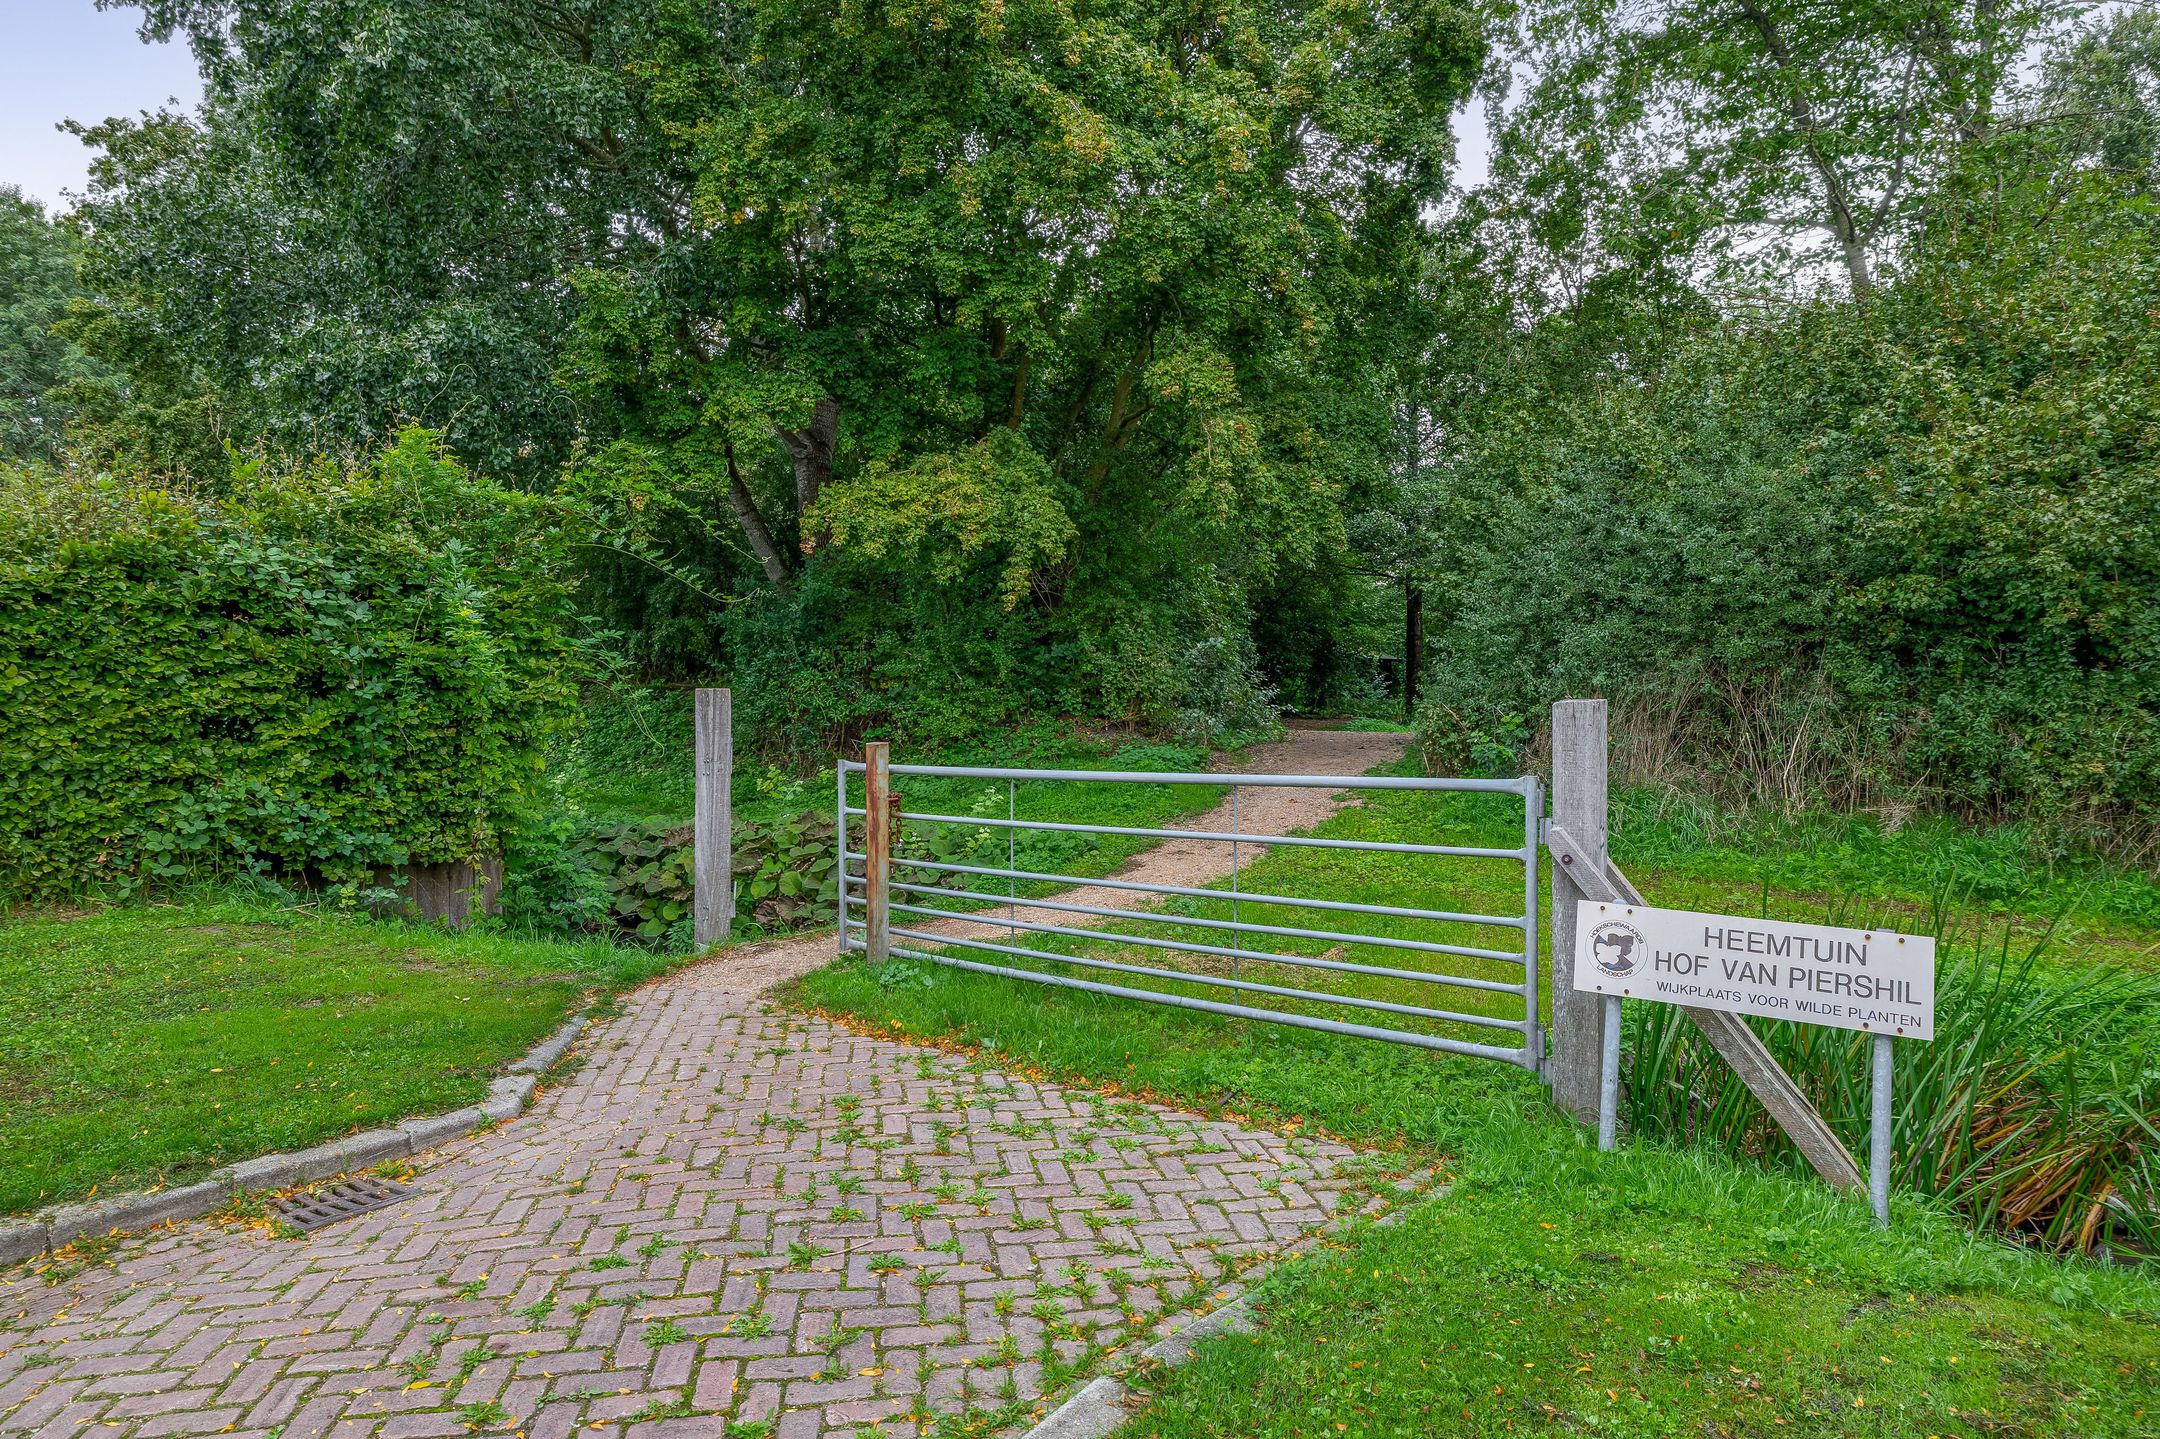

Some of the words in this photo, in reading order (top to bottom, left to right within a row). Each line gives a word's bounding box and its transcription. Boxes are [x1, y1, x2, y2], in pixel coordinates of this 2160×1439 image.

[1704, 926, 1867, 967] HEEMTUIN
[1596, 965, 1634, 978] LANDSCHAP
[1655, 949, 1710, 976] HOF
[1721, 958, 1778, 987] VAN
[1788, 966, 1922, 1006] PIERSHIL
[1656, 980, 1742, 1003] WIJKPLAATS
[1748, 993, 1789, 1009] VOOR
[1795, 999, 1842, 1017] WILDE
[1848, 1007, 1922, 1028] PLANTEN
